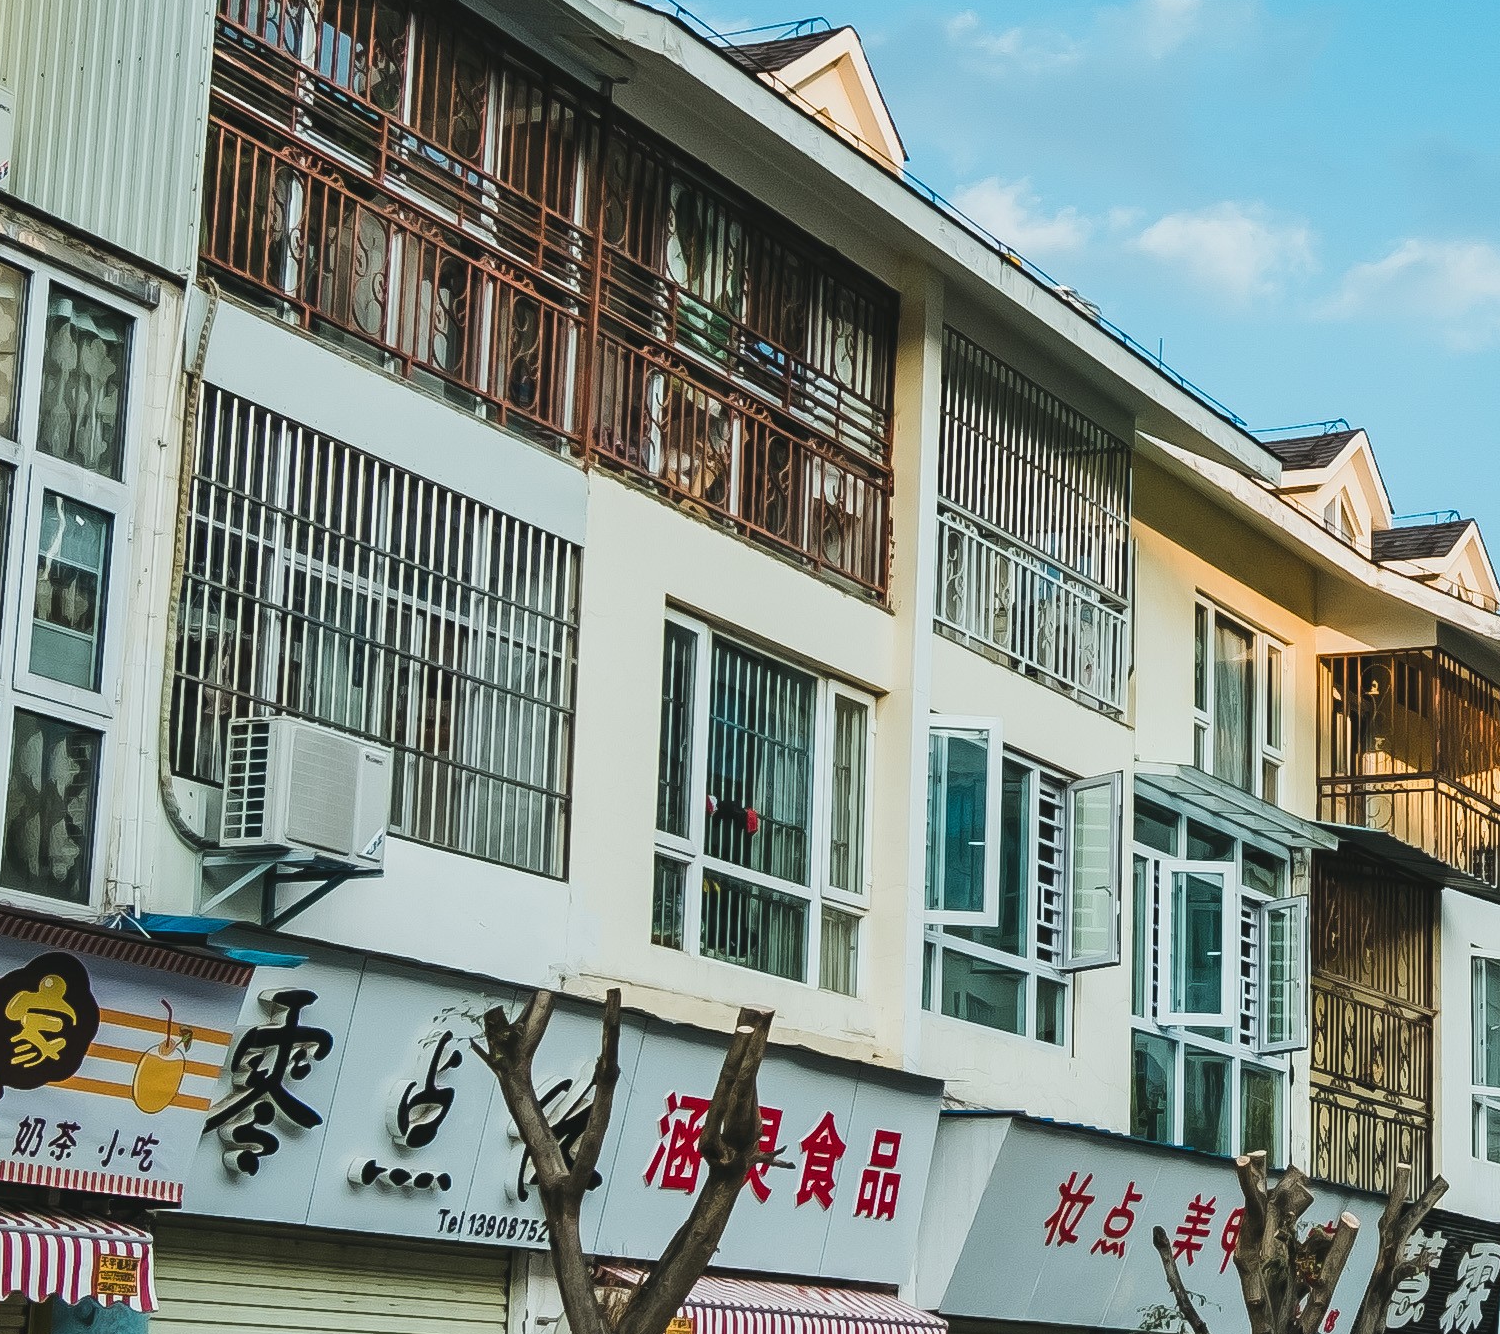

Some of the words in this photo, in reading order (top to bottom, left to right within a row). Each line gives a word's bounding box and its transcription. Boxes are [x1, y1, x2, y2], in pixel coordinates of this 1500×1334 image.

[11, 1115, 82, 1161] 奶茶
[97, 1132, 161, 1172] 小吃
[437, 1208, 466, 1234] Tel
